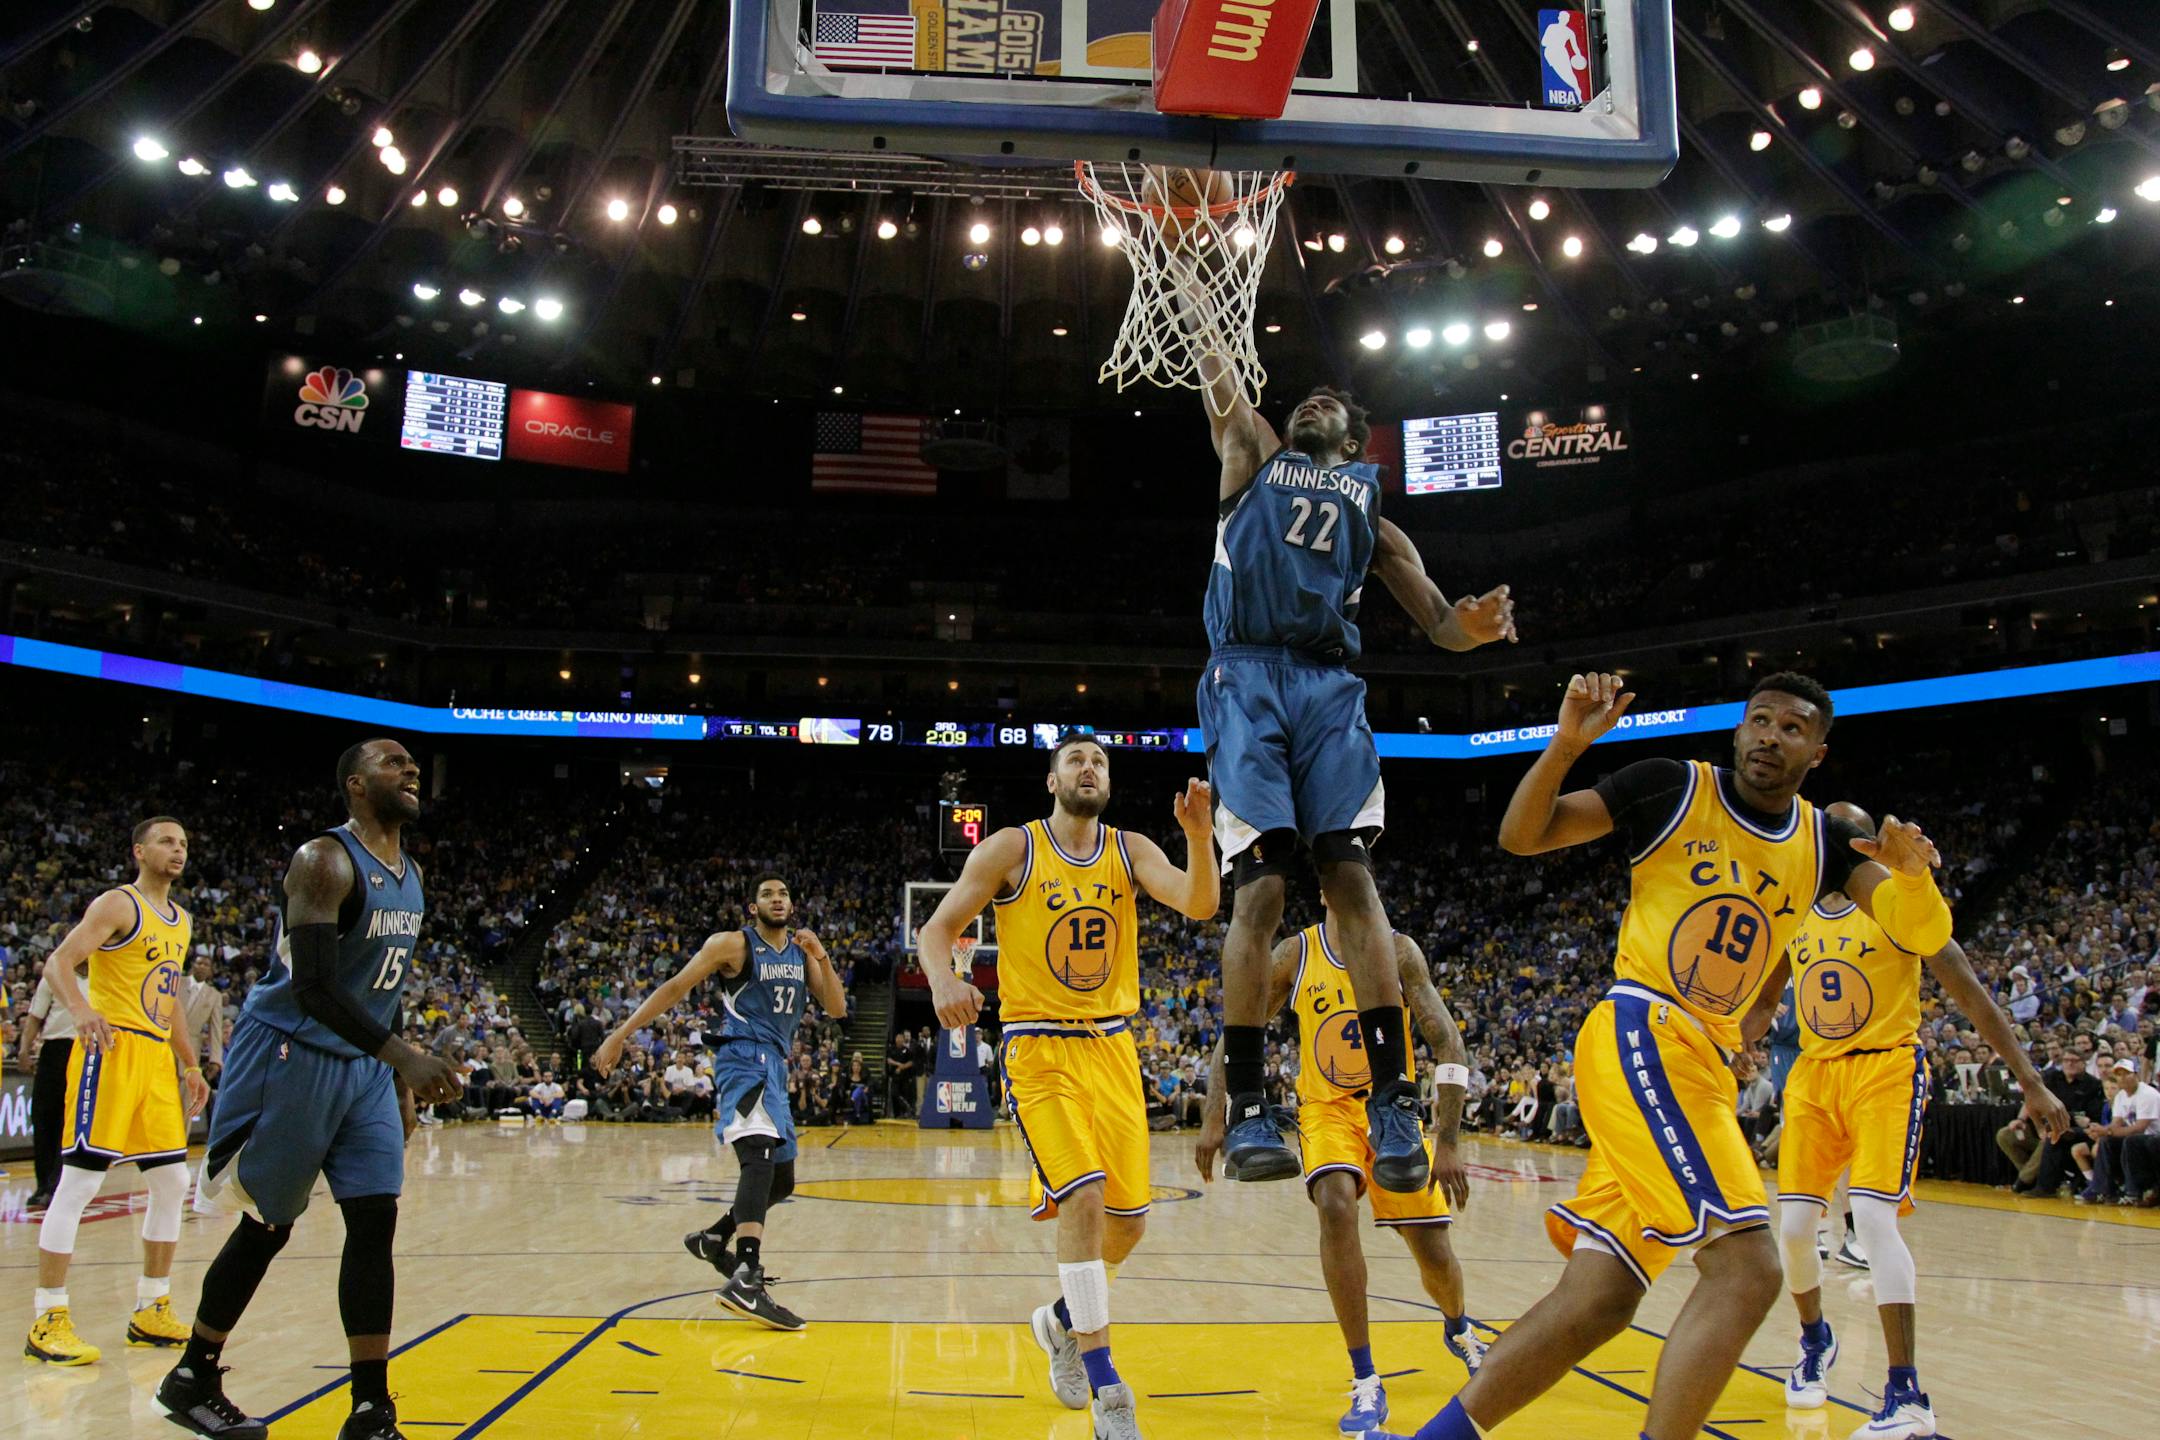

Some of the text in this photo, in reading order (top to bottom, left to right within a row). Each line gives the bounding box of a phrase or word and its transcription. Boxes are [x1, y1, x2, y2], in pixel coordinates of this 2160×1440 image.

[927, 11, 939, 71] GOLDEN STAT
[1000, 14, 1035, 69] 2015
[1548, 89, 1577, 105] NBA
[293, 403, 366, 434] CSN
[524, 419, 614, 444] ORACLE
[1507, 430, 1628, 459] CENTRAL
[1265, 460, 1370, 514] MINNESOTA
[1283, 496, 1340, 553] 22
[453, 708, 687, 726] CACHE CREEK CASINO RESORT
[743, 724, 752, 735] 5
[759, 725, 777, 736] TOL
[778, 725, 788, 737] 3
[790, 725, 798, 737] 1
[935, 722, 957, 732] 3RD
[1470, 729, 1516, 746] CACHE
[1635, 709, 1687, 727] RESORT
[867, 723, 894, 742] 78
[925, 731, 967, 746] 2:09
[1000, 727, 1027, 745] 68
[1114, 734, 1123, 745] 2
[1126, 735, 1134, 745] 1
[1153, 735, 1160, 746] 1
[953, 808, 982, 823] 2:09
[964, 823, 978, 845] 9
[1683, 839, 1719, 857] The
[1039, 877, 1062, 894] The
[1047, 883, 1123, 911] CITY
[1690, 860, 1796, 918] CITY
[1069, 917, 1106, 951] 12
[1705, 904, 1759, 964] 19
[1791, 932, 1809, 950] The
[146, 941, 183, 962] CIT
[1797, 936, 1876, 965] CITY
[157, 967, 180, 997] 30
[372, 946, 408, 991] 15
[760, 963, 804, 982] MINNESOTA
[773, 985, 796, 1014] 32
[1306, 981, 1327, 998] The
[1820, 970, 1841, 1002] 9
[1313, 988, 1345, 1014] CI
[1340, 1018, 1362, 1049] 4
[1626, 1029, 1697, 1185] WARRIORS
